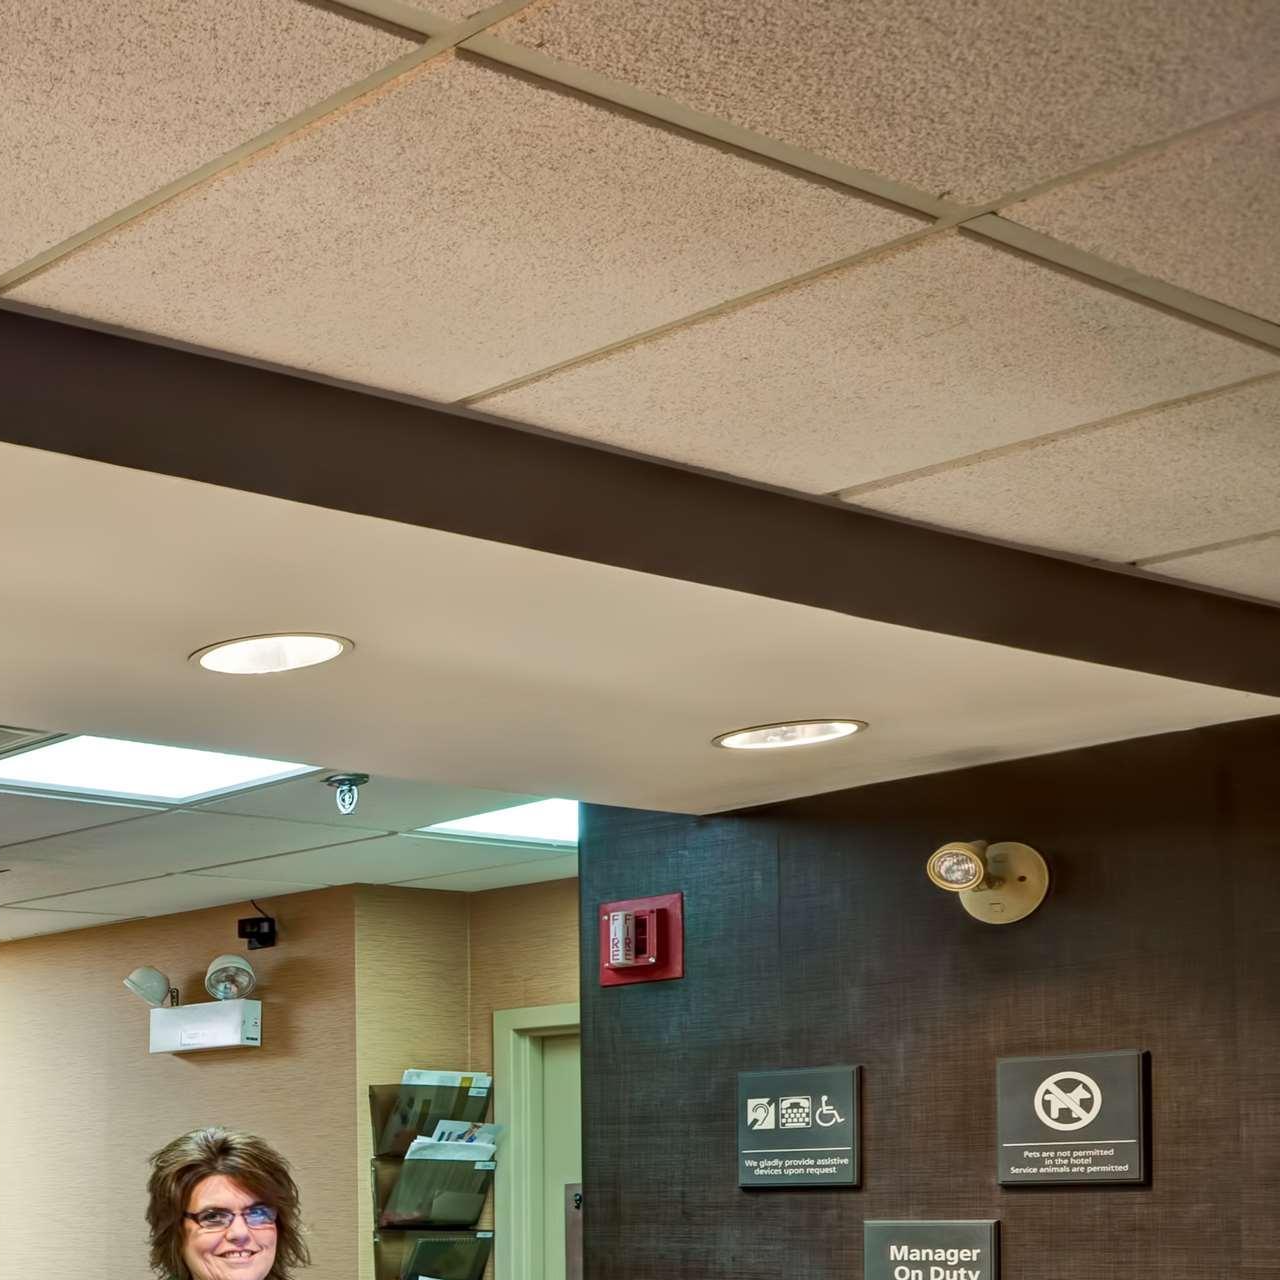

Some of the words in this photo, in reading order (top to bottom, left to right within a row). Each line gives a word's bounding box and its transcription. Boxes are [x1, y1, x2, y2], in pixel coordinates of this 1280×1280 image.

[612, 913, 621, 961] FIRE
[624, 913, 634, 961] FIRE
[1023, 1150, 1040, 1158] Pets
[1073, 1148, 1115, 1159] permitted
[744, 1159, 758, 1167] We
[759, 1158, 784, 1169] gladly
[785, 1158, 815, 1168] provide
[816, 1156, 849, 1167] assistive
[1070, 1157, 1092, 1165] hotel
[754, 1167, 782, 1175] devices
[783, 1168, 805, 1176] upon
[806, 1166, 837, 1176] request
[1010, 1166, 1038, 1174] Service
[1039, 1165, 1070, 1173] animals
[1087, 1163, 1129, 1174] permitted
[889, 1245, 981, 1266] Manager
